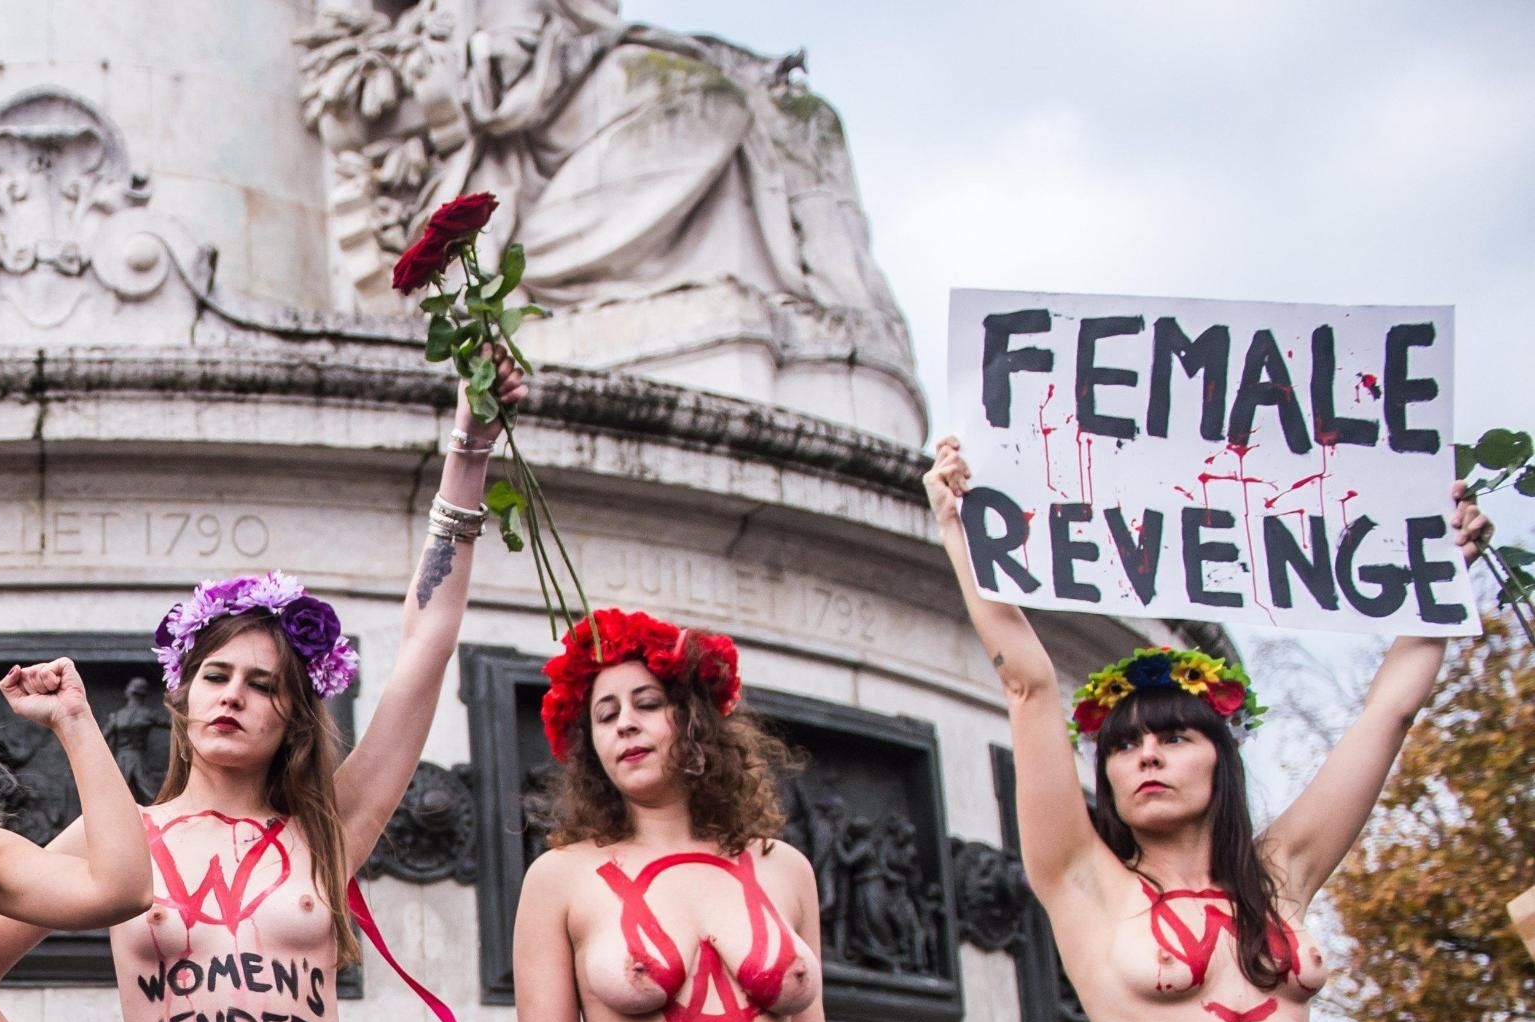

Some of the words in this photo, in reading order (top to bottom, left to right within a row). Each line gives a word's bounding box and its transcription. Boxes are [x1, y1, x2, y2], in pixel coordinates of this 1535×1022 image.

[982, 308, 1441, 455] FEMALE
[145, 512, 271, 558] 1790
[961, 486, 1468, 625] REVENGE
[137, 952, 325, 1018] WOMEN'S
